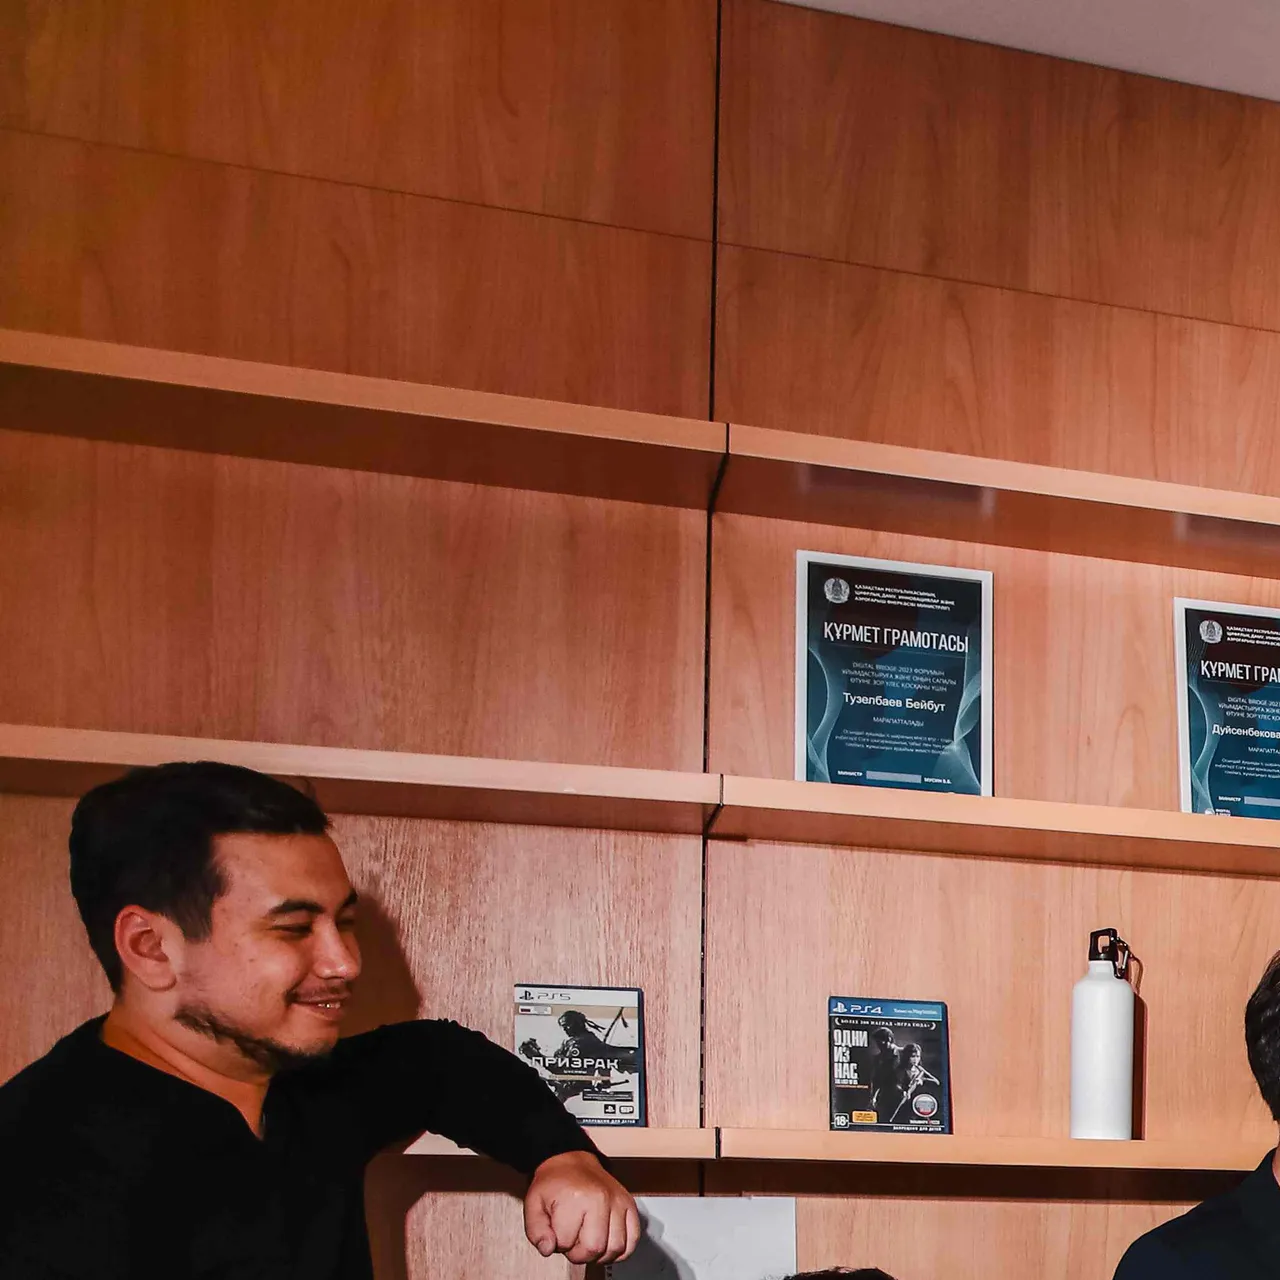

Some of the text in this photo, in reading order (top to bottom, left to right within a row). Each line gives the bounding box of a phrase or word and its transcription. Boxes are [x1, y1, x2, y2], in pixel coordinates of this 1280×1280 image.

[823, 621, 968, 653] ҚҰРМЕТ ГРАМОТАСЫ
[1201, 660, 1251, 682] ҚҰРМЕТ
[843, 692, 945, 713] Тузелбаев Бейбут
[538, 992, 571, 1001] PS5
[851, 1004, 883, 1014] PS4
[834, 1029, 868, 1047] ОДНИ
[834, 1046, 850, 1062] ИЗ
[531, 1057, 619, 1069] ПРИЗРАК
[834, 1063, 858, 1079] НАС
